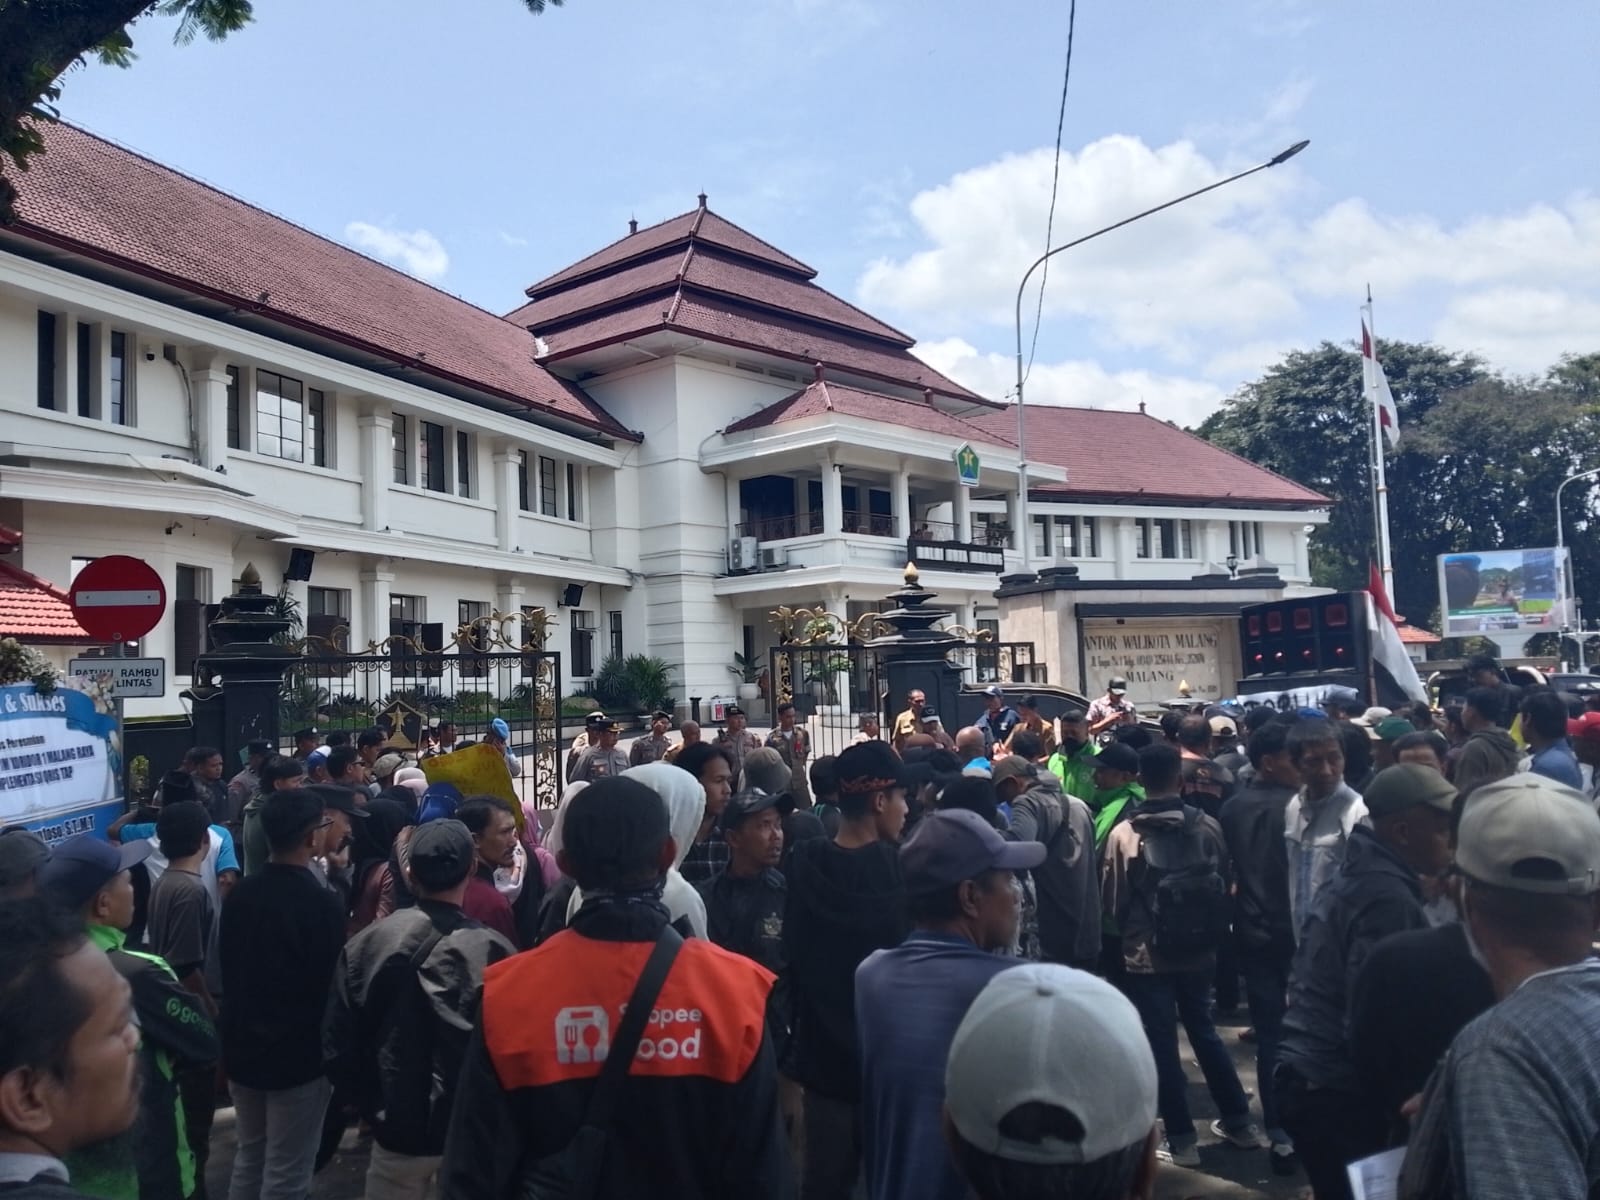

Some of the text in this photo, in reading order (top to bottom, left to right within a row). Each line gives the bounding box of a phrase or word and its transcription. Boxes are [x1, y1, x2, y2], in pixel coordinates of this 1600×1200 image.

[1084, 633, 1217, 650] ANTOR WALIKOTA MALANG
[120, 668, 159, 678] RAMBU
[1126, 671, 1174, 682] MALANG
[116, 679, 152, 688] LINTAS
[5, 693, 18, 712] &
[19, 692, 66, 712] Sukses
[46, 747, 77, 763] MALANG
[76, 744, 95, 759] RAYA
[59, 765, 73, 779] TAP
[619, 1002, 702, 1028] opee
[636, 1028, 702, 1060] ood
